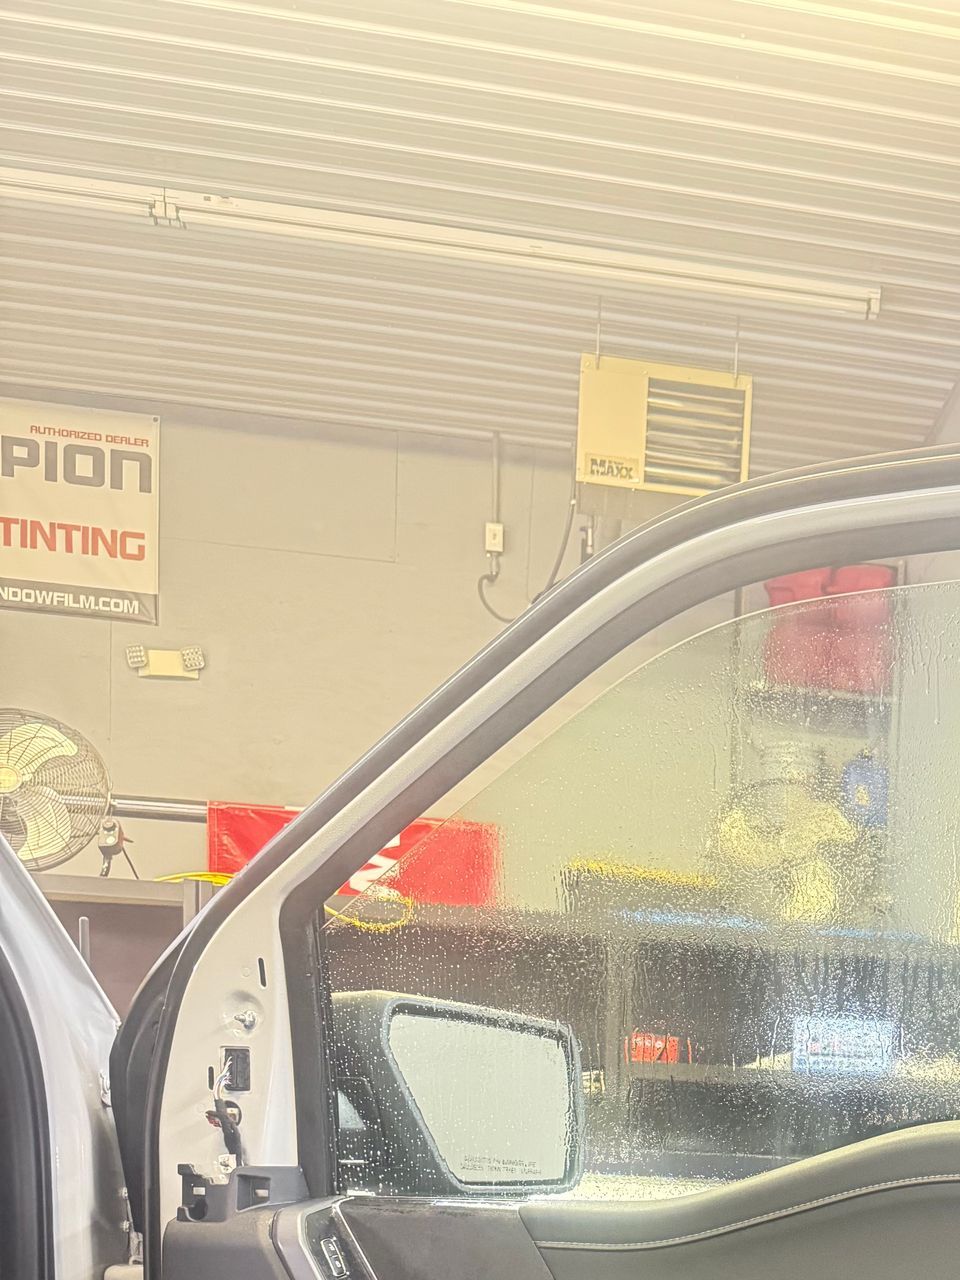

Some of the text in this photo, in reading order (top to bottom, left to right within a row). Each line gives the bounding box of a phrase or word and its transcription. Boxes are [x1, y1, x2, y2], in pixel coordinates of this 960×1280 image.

[30, 425, 149, 448] AUTHORIZED DEALER
[0, 516, 146, 561] TINTING
